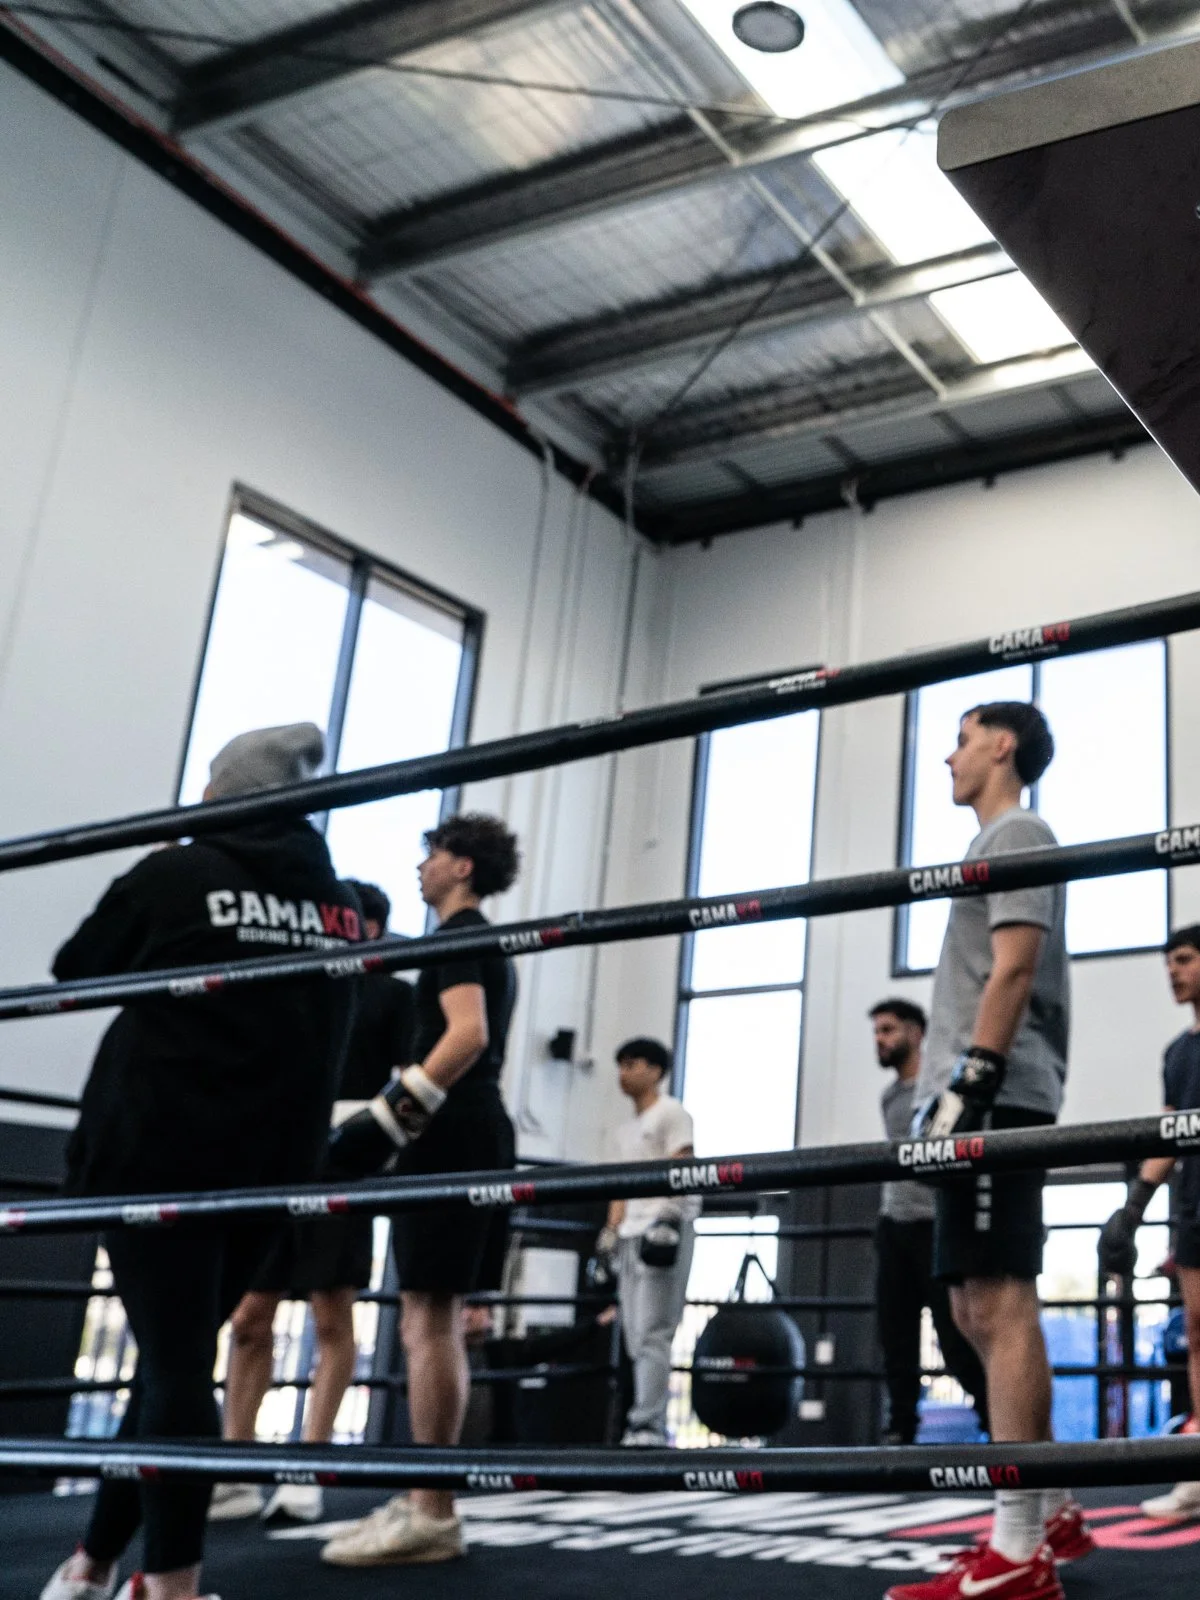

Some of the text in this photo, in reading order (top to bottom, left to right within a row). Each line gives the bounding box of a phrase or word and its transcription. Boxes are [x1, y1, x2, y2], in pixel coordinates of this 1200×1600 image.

[206, 889, 361, 941] CAMAKO
[898, 1136, 985, 1166] CAMAKO
[670, 1163, 744, 1190] CAMAKO
[683, 1470, 763, 1490] CAMAKO
[929, 1465, 1021, 1488] CAMAKO
